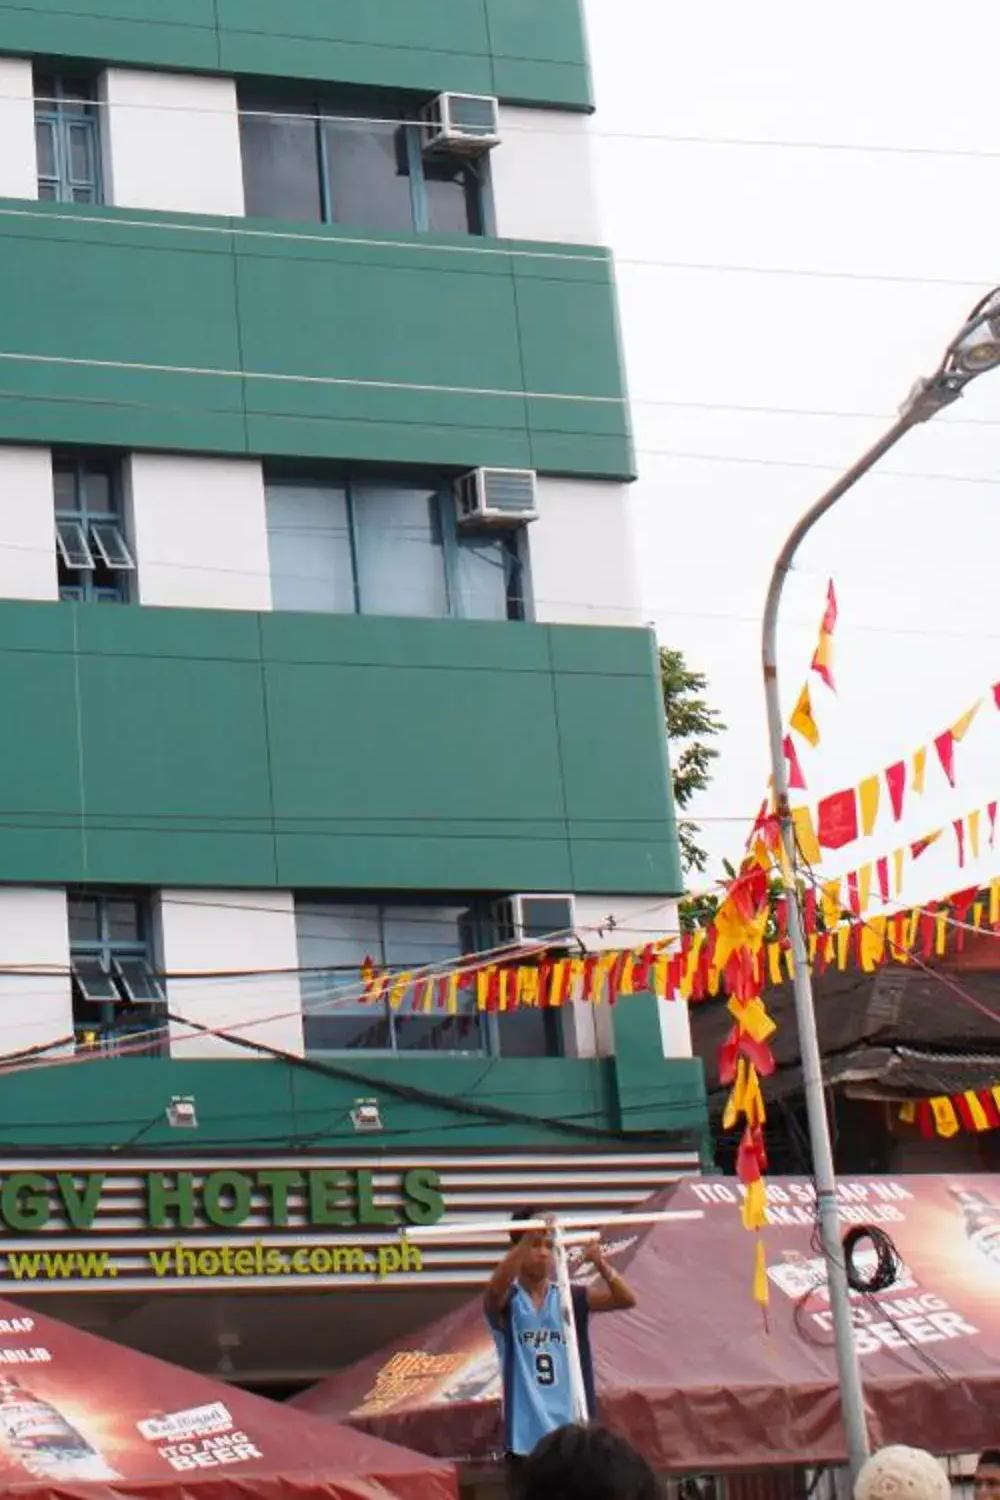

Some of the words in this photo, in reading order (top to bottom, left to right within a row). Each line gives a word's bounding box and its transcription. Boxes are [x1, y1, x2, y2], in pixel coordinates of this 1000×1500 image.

[1, 1171, 107, 1232] GV
[148, 1167, 447, 1229] HOTELS
[850, 1311, 982, 1355] BEER
[535, 1353, 555, 1385] 9
[168, 1442, 265, 1472] BEER
